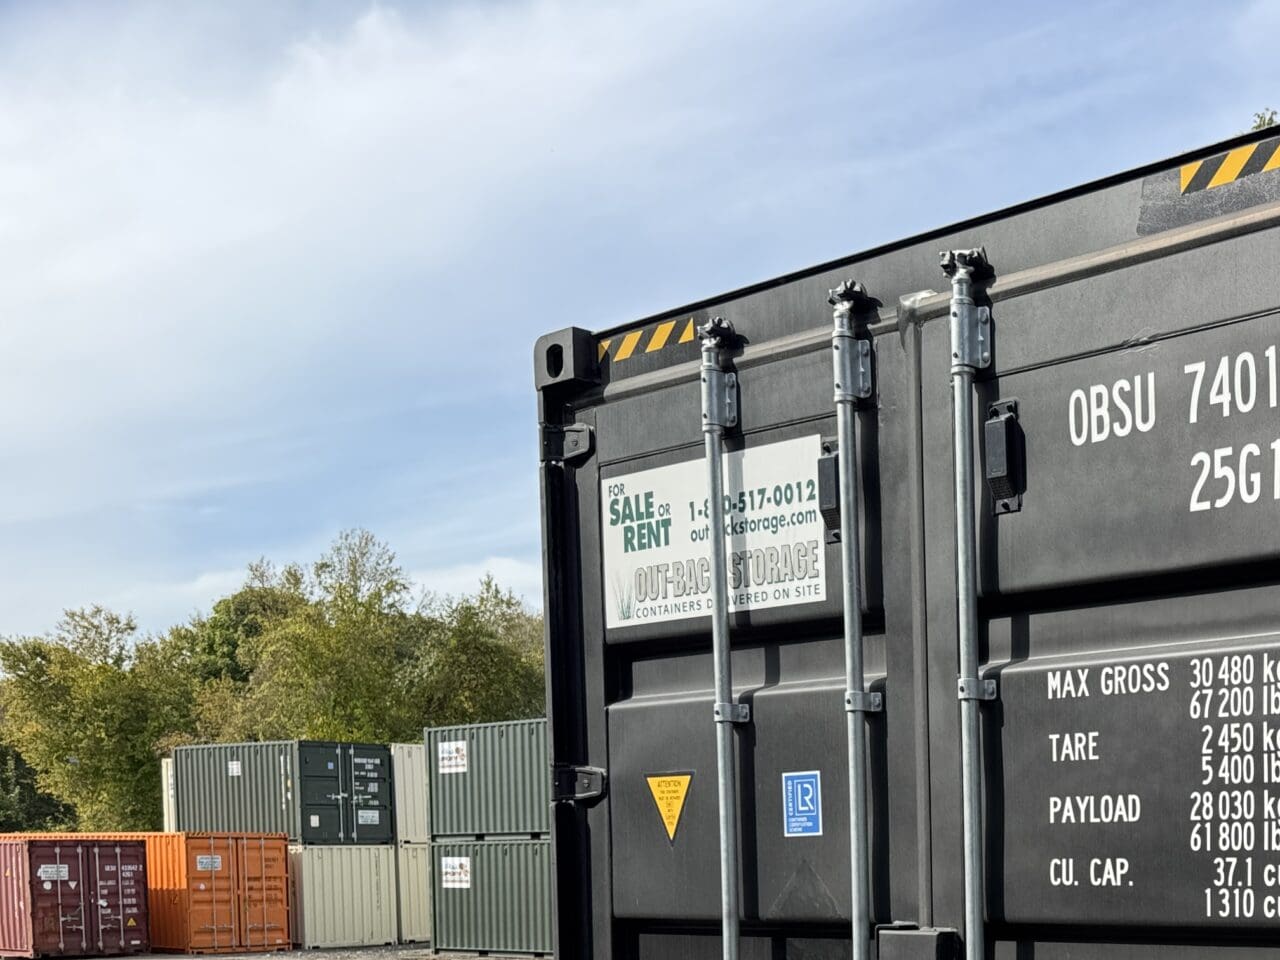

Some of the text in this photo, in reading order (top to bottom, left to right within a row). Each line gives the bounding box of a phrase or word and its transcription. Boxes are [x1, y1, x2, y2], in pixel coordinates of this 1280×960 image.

[1068, 371, 1156, 446] OBSU
[608, 483, 626, 497] FOR
[689, 479, 816, 521] 1-80-517-0012
[609, 491, 672, 526] SALE OR
[623, 518, 672, 553] RENT
[690, 509, 817, 543] outckstorage.com
[634, 540, 820, 602] OUT-BAC STORAGE
[635, 584, 821, 618] CONTAINERS DVERED ON SITE
[1047, 668, 1090, 700] MAX
[1100, 662, 1170, 695] GROSS
[1049, 732, 1099, 762] TARE
[1049, 794, 1141, 824] PAYLOAD
[1049, 858, 1079, 886] CU.
[1090, 858, 1134, 887] CAP.
[1213, 857, 1253, 887] 37.1
